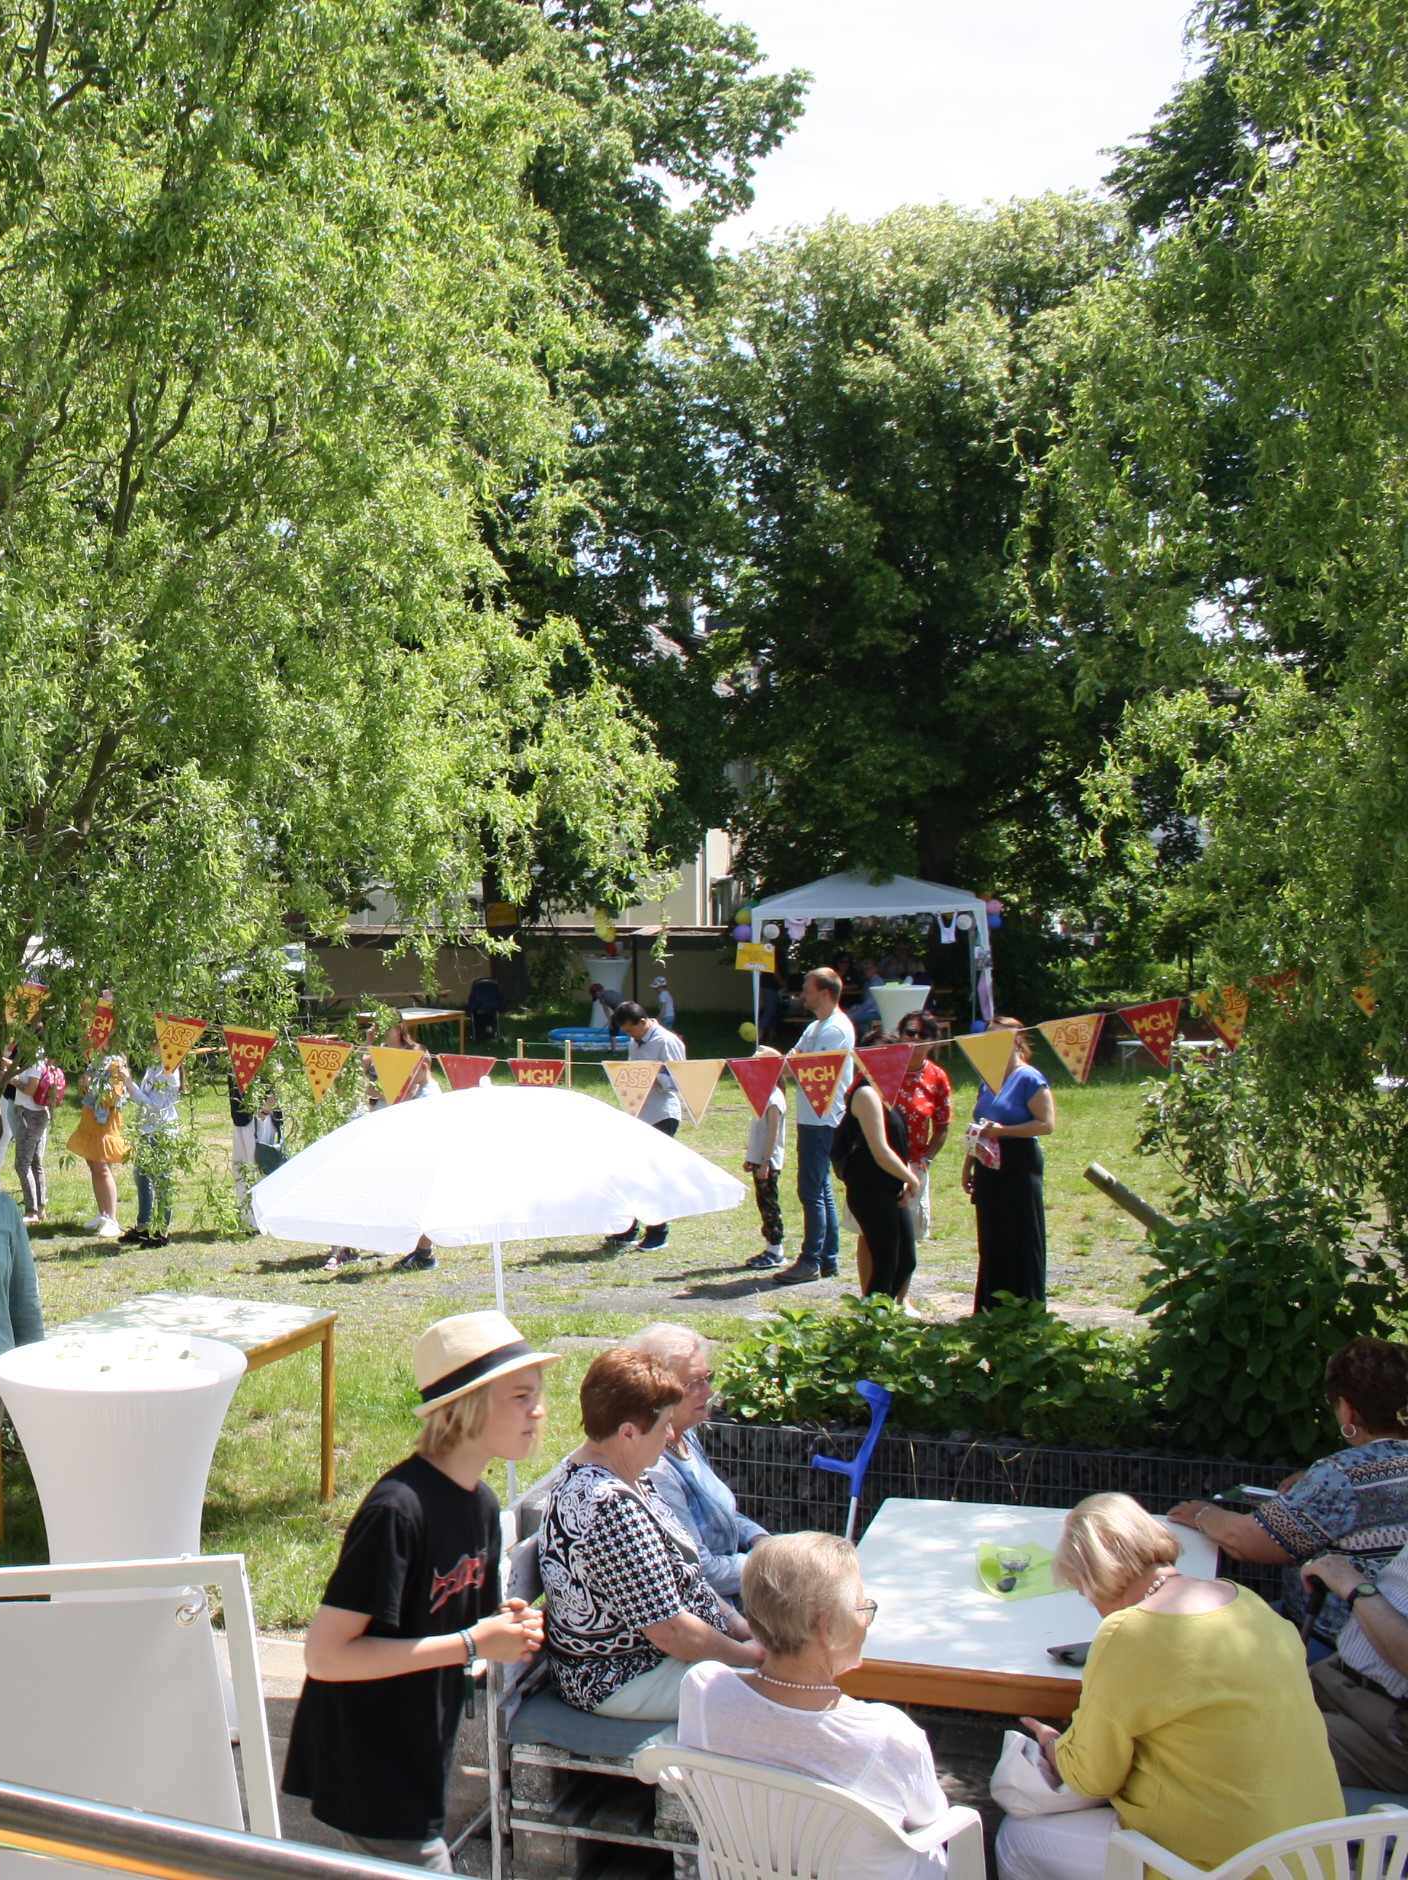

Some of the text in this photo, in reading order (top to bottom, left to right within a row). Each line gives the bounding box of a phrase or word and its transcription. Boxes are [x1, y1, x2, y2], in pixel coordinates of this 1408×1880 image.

[92, 1015, 114, 1032] GH
[1133, 1011, 1173, 1034] MGH
[159, 1024, 195, 1048] ASB
[1052, 1022, 1092, 1047] ASB
[231, 1042, 265, 1060] MGH
[304, 1049, 342, 1071] ASB
[518, 1068, 555, 1085] MGH
[614, 1067, 653, 1089] ASB
[797, 1065, 836, 1082] MGH
